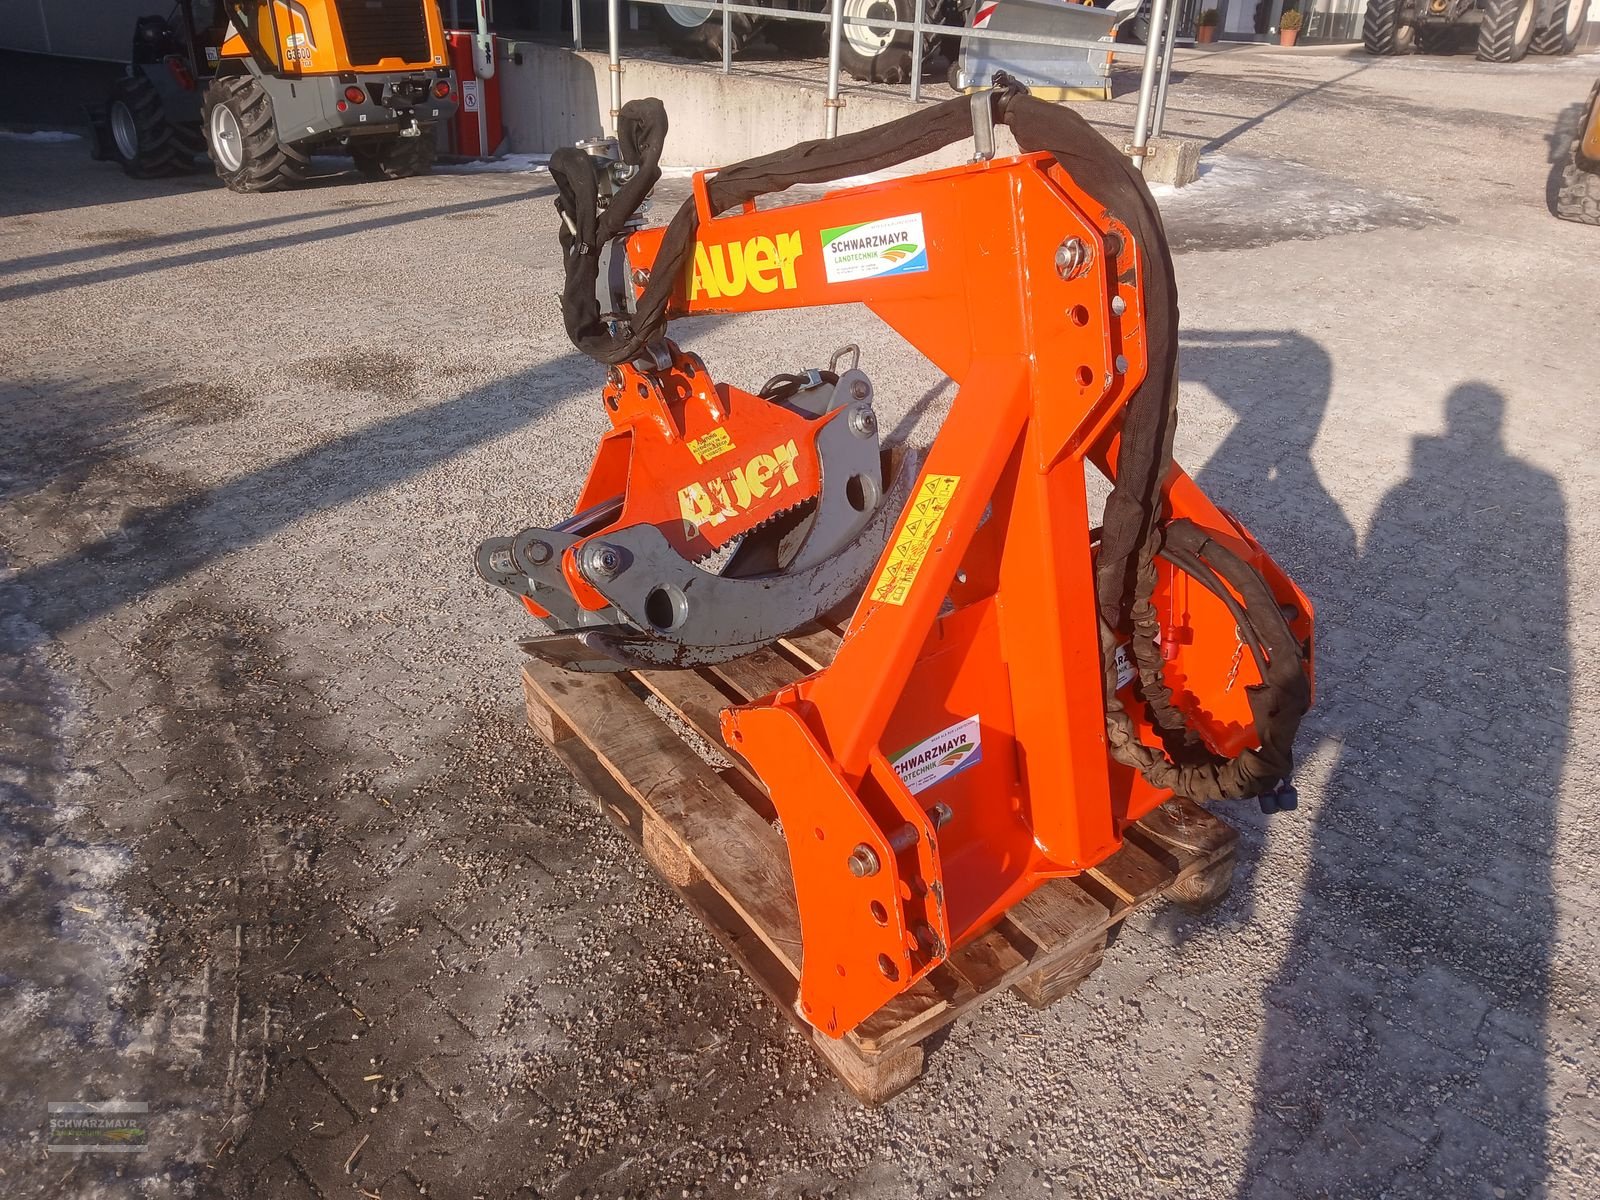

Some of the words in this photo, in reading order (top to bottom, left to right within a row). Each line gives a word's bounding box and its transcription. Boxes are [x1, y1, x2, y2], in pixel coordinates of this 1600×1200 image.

[831, 231, 908, 253] SCHWARZMAYR
[687, 229, 803, 300] Auer
[834, 251, 878, 264] LANDTECHNIK
